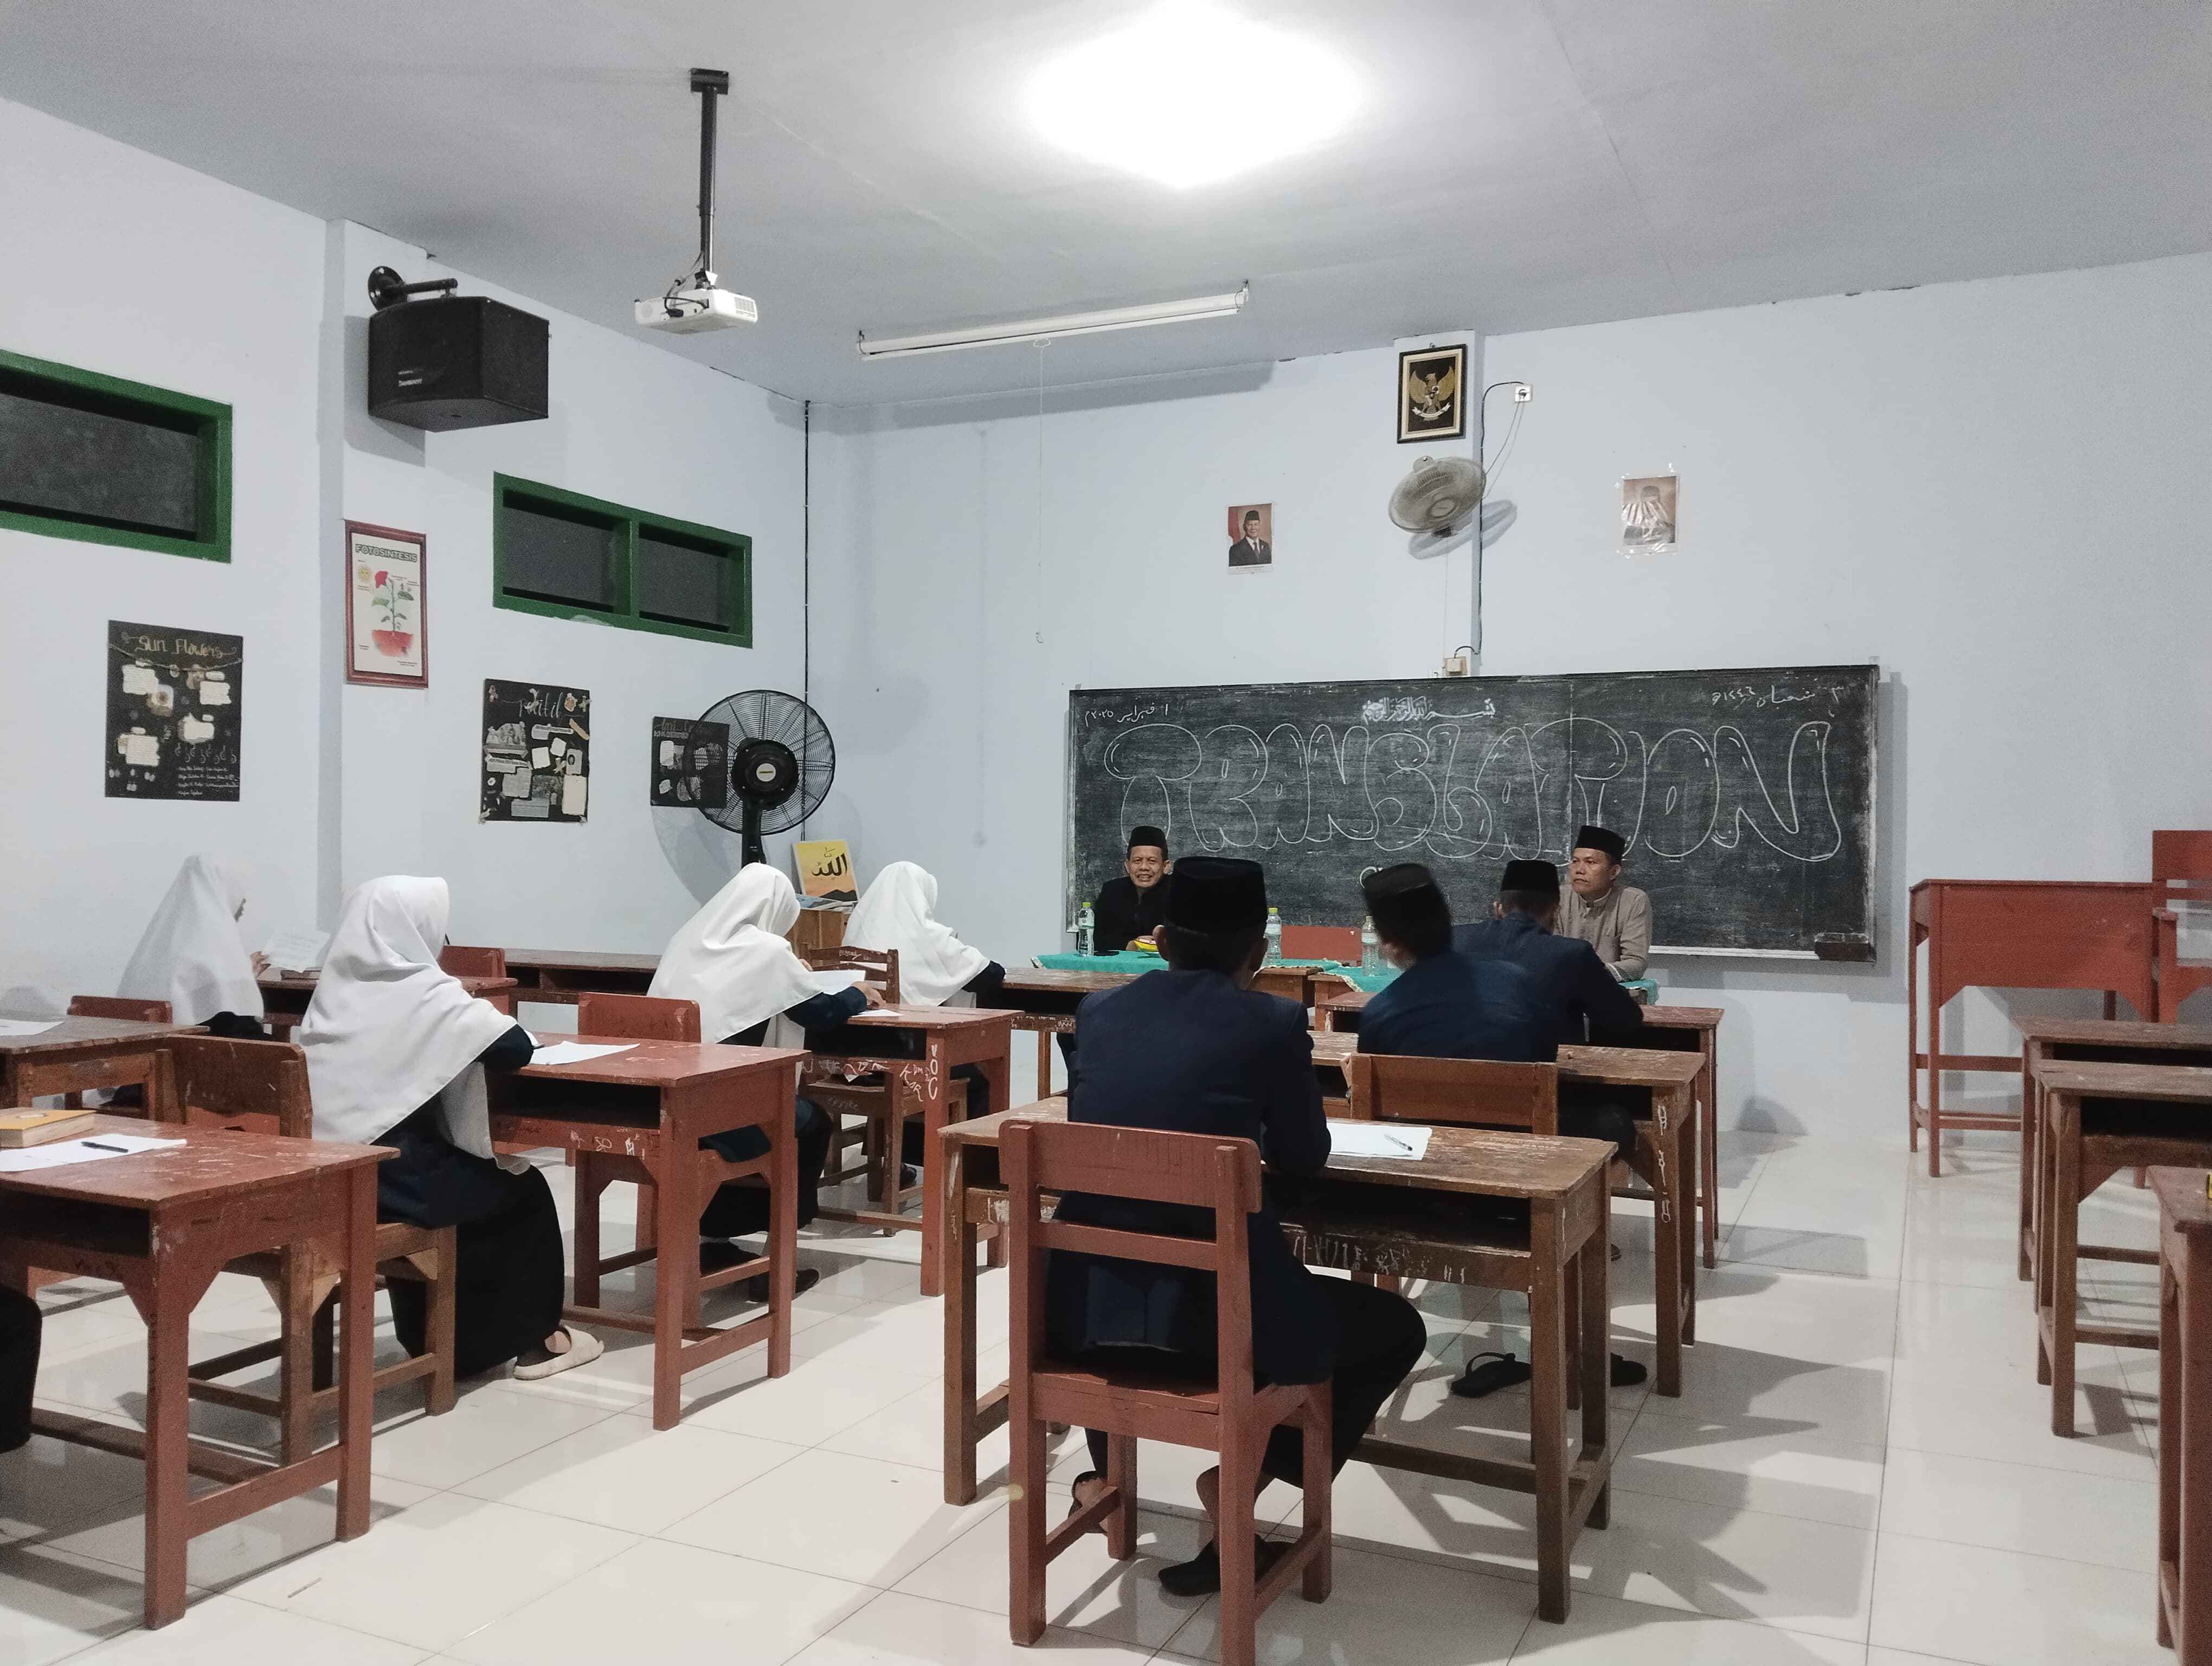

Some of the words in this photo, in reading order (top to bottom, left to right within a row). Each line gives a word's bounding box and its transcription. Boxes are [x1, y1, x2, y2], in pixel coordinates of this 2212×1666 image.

[355, 543, 418, 563] FOTOSINTESIS
[134, 635, 169, 652] Sun
[1757, 684, 1816, 709] شعبان
[1117, 702, 1155, 722] فبراير
